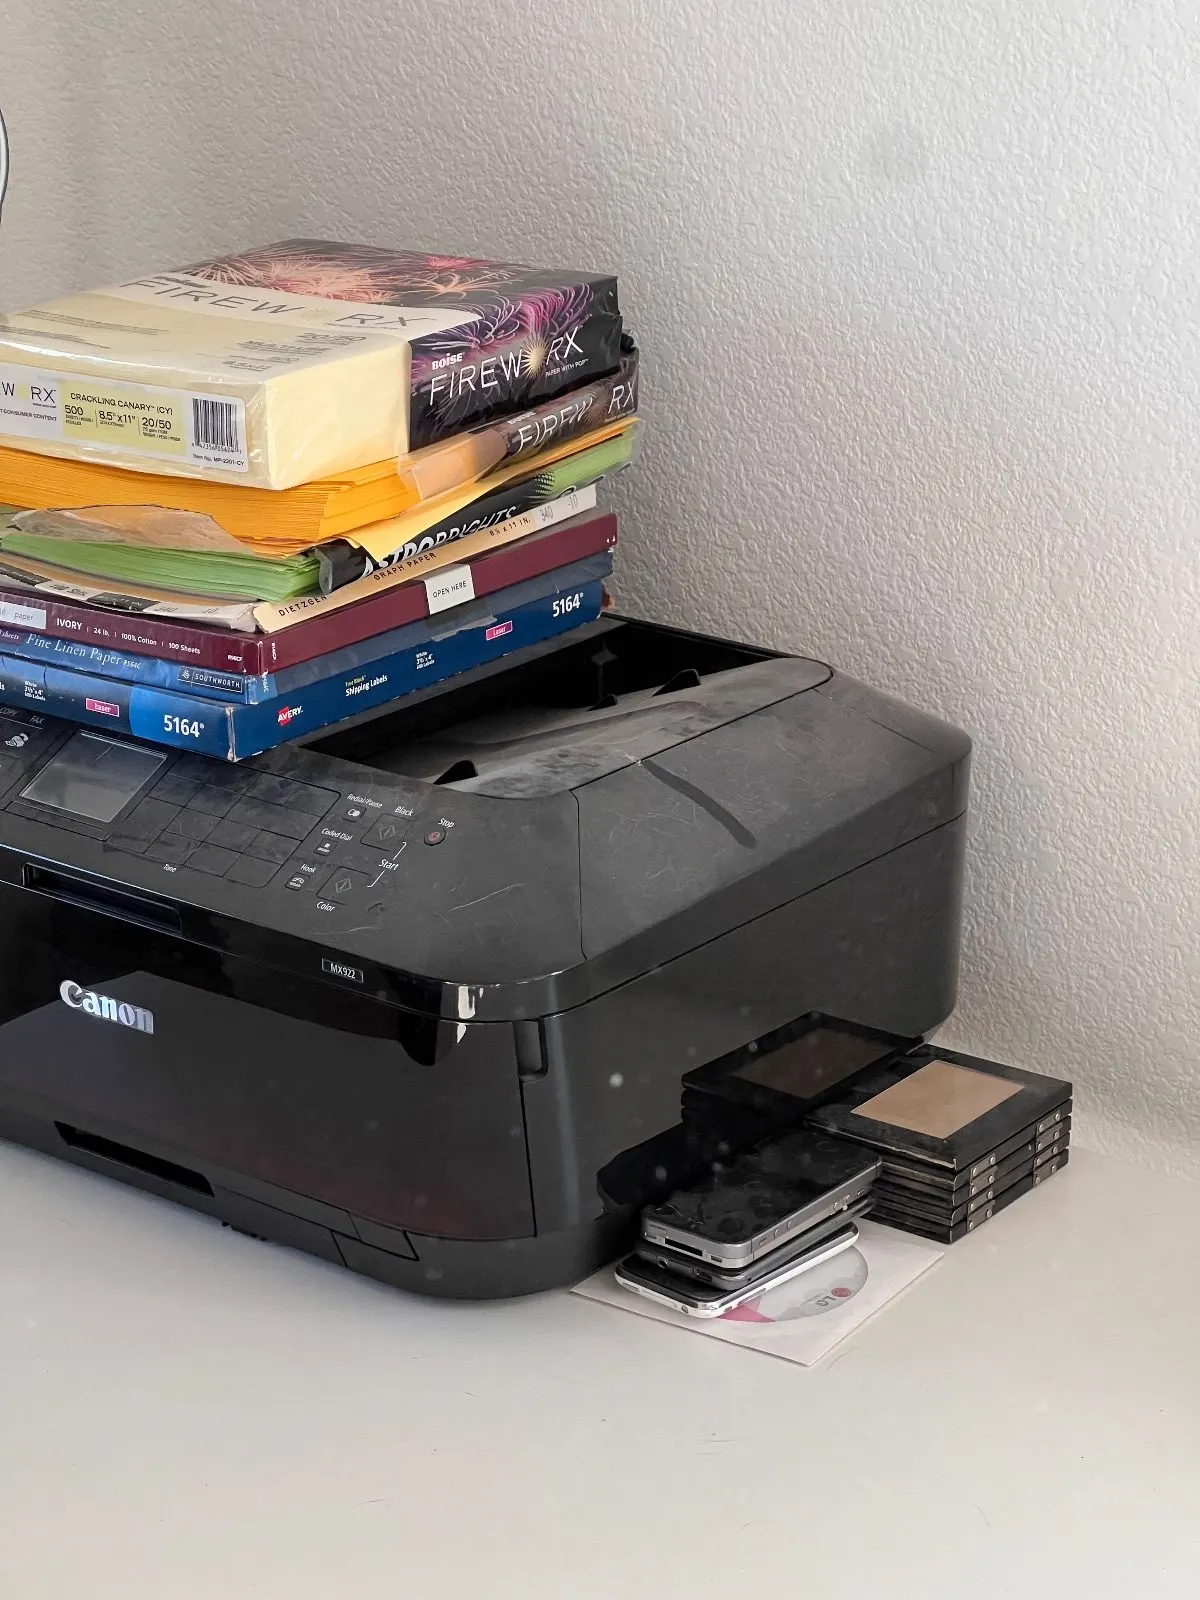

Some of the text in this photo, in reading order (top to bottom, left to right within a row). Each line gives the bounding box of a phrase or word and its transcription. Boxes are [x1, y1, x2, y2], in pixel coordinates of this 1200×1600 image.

[546, 367, 561, 377] PAPER
[561, 364, 574, 372] WITH
[64, 405, 84, 416] 500
[70, 392, 117, 407] CRACKLING
[156, 406, 173, 416] (CY)
[3, 408, 33, 418] CONSUMER
[33, 413, 57, 421] CONTENT
[141, 417, 172, 430] 20/50
[373, 552, 437, 581] GRAPH PAPER
[432, 580, 467, 598] OPEN HERE
[278, 594, 328, 616] DIETZGEN
[14, 612, 34, 621] paper
[2, 631, 19, 640] sheets
[56, 617, 83, 631] IVORY
[102, 628, 110, 637] lb.
[121, 632, 137, 642] 100%
[137, 636, 157, 646] Cotton
[168, 642, 180, 650] 100
[180, 645, 201, 655] Sheets
[493, 626, 506, 636] Laser
[26, 633, 52, 649] Fine
[54, 640, 86, 657] Linen
[89, 647, 122, 666] Paper
[195, 672, 241, 688] SOUTHWORTH
[345, 674, 388, 697] Shipping Labels
[94, 702, 112, 713] Laser
[277, 705, 303, 723] AVERY
[29, 715, 45, 724] FAX
[346, 793, 383, 809] Redial/Pause
[394, 806, 415, 817] Black
[438, 817, 455, 829] Stop
[321, 827, 353, 841] Coded Dial
[300, 863, 317, 874] Hook
[378, 858, 400, 871] Start
[316, 901, 336, 912] Color
[330, 961, 356, 980] MX922
[59, 979, 154, 1034] Canon
